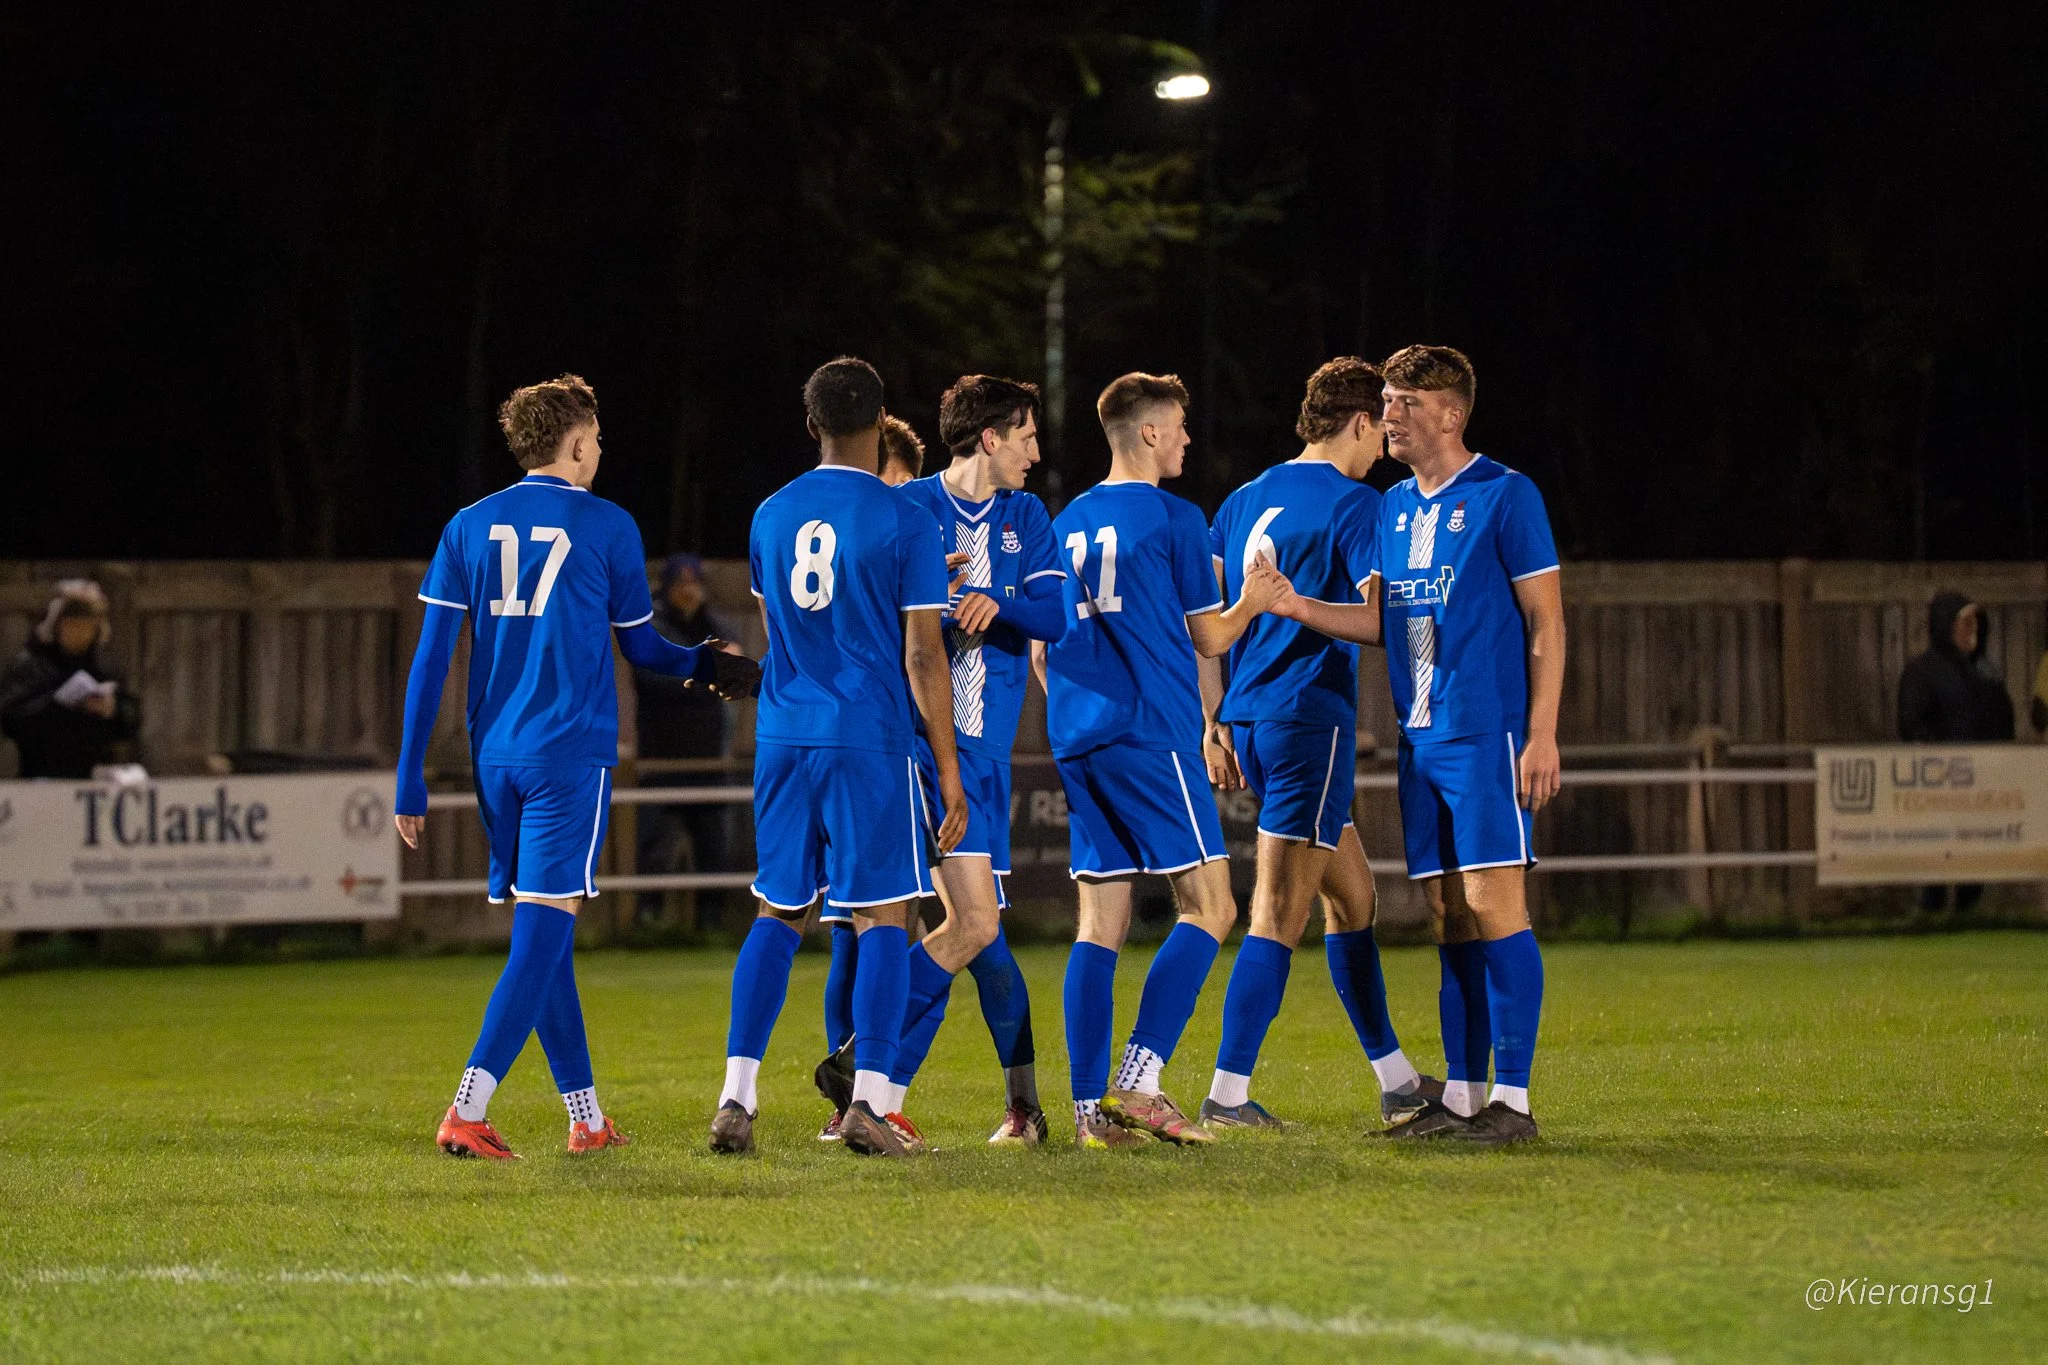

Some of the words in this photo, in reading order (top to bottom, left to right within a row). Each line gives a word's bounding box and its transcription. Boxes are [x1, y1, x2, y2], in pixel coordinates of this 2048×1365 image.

[488, 524, 572, 617] 17
[790, 519, 837, 612] 8
[1065, 525, 1123, 620] 11
[1243, 506, 1285, 580] 6
[75, 786, 269, 847] TClarke
